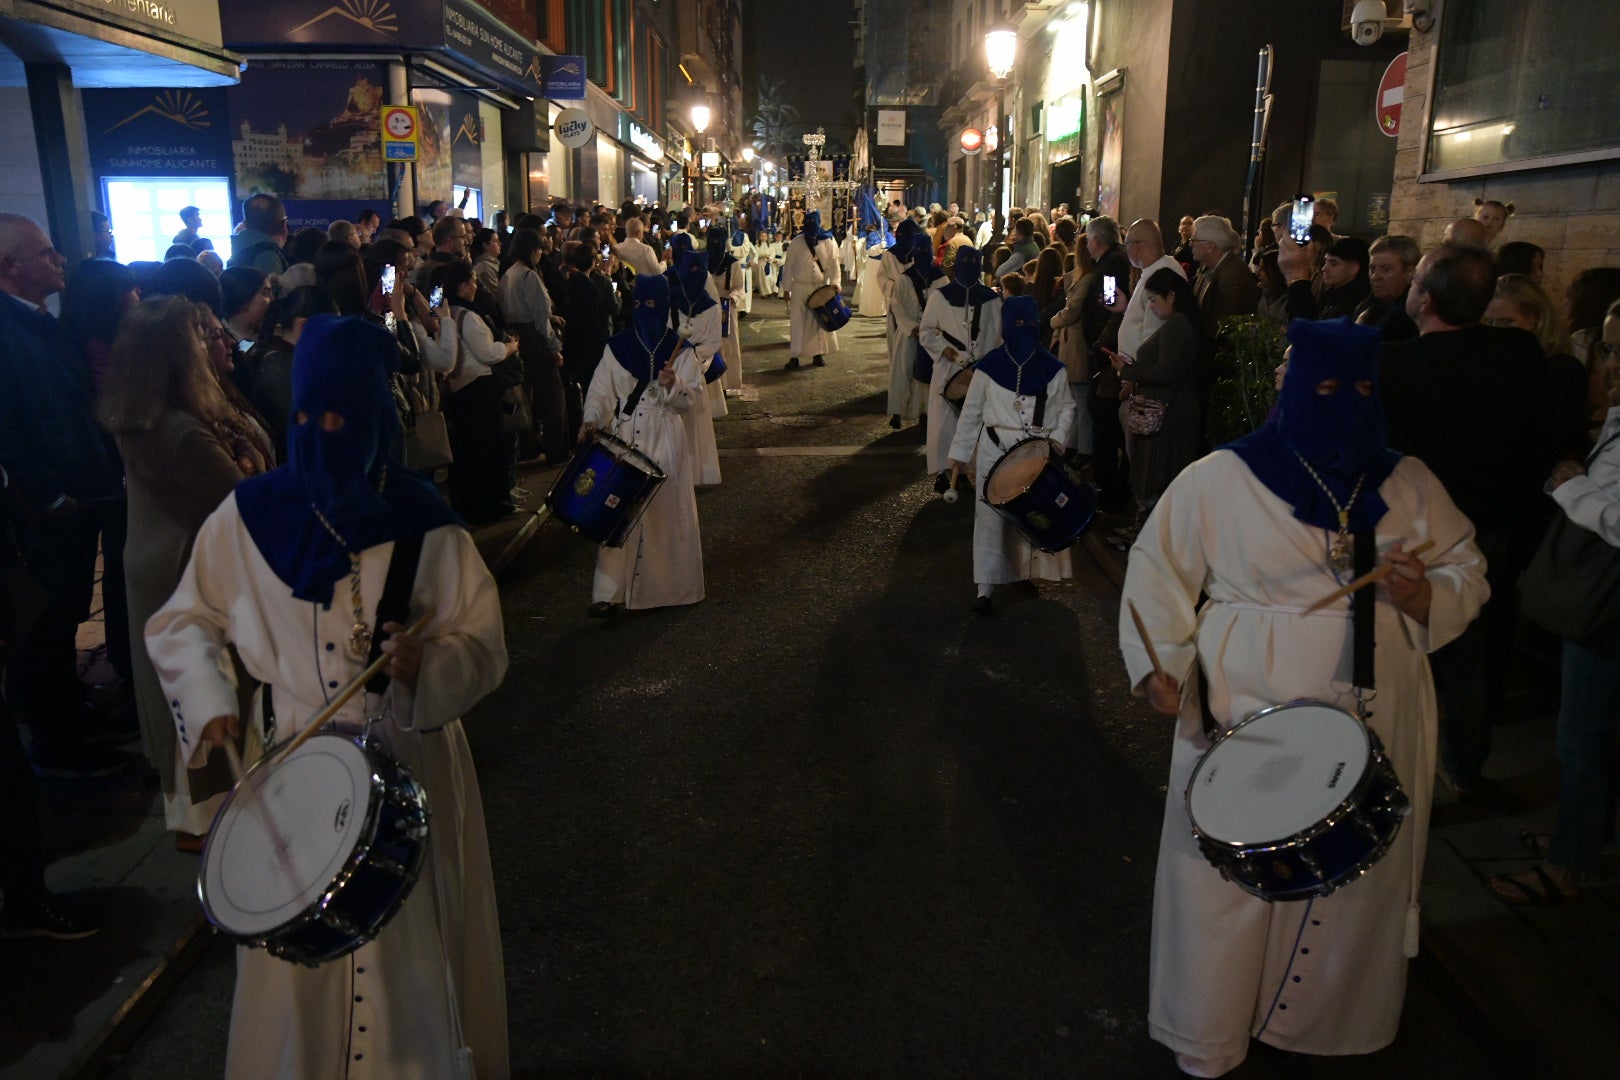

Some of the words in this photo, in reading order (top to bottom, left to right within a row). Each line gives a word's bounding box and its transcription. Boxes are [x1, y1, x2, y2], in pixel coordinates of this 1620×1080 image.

[105, 0, 176, 25] mentaria
[559, 120, 587, 135] lucky
[127, 146, 197, 156] INMOBILIARIA
[165, 158, 218, 169] ALICANTE
